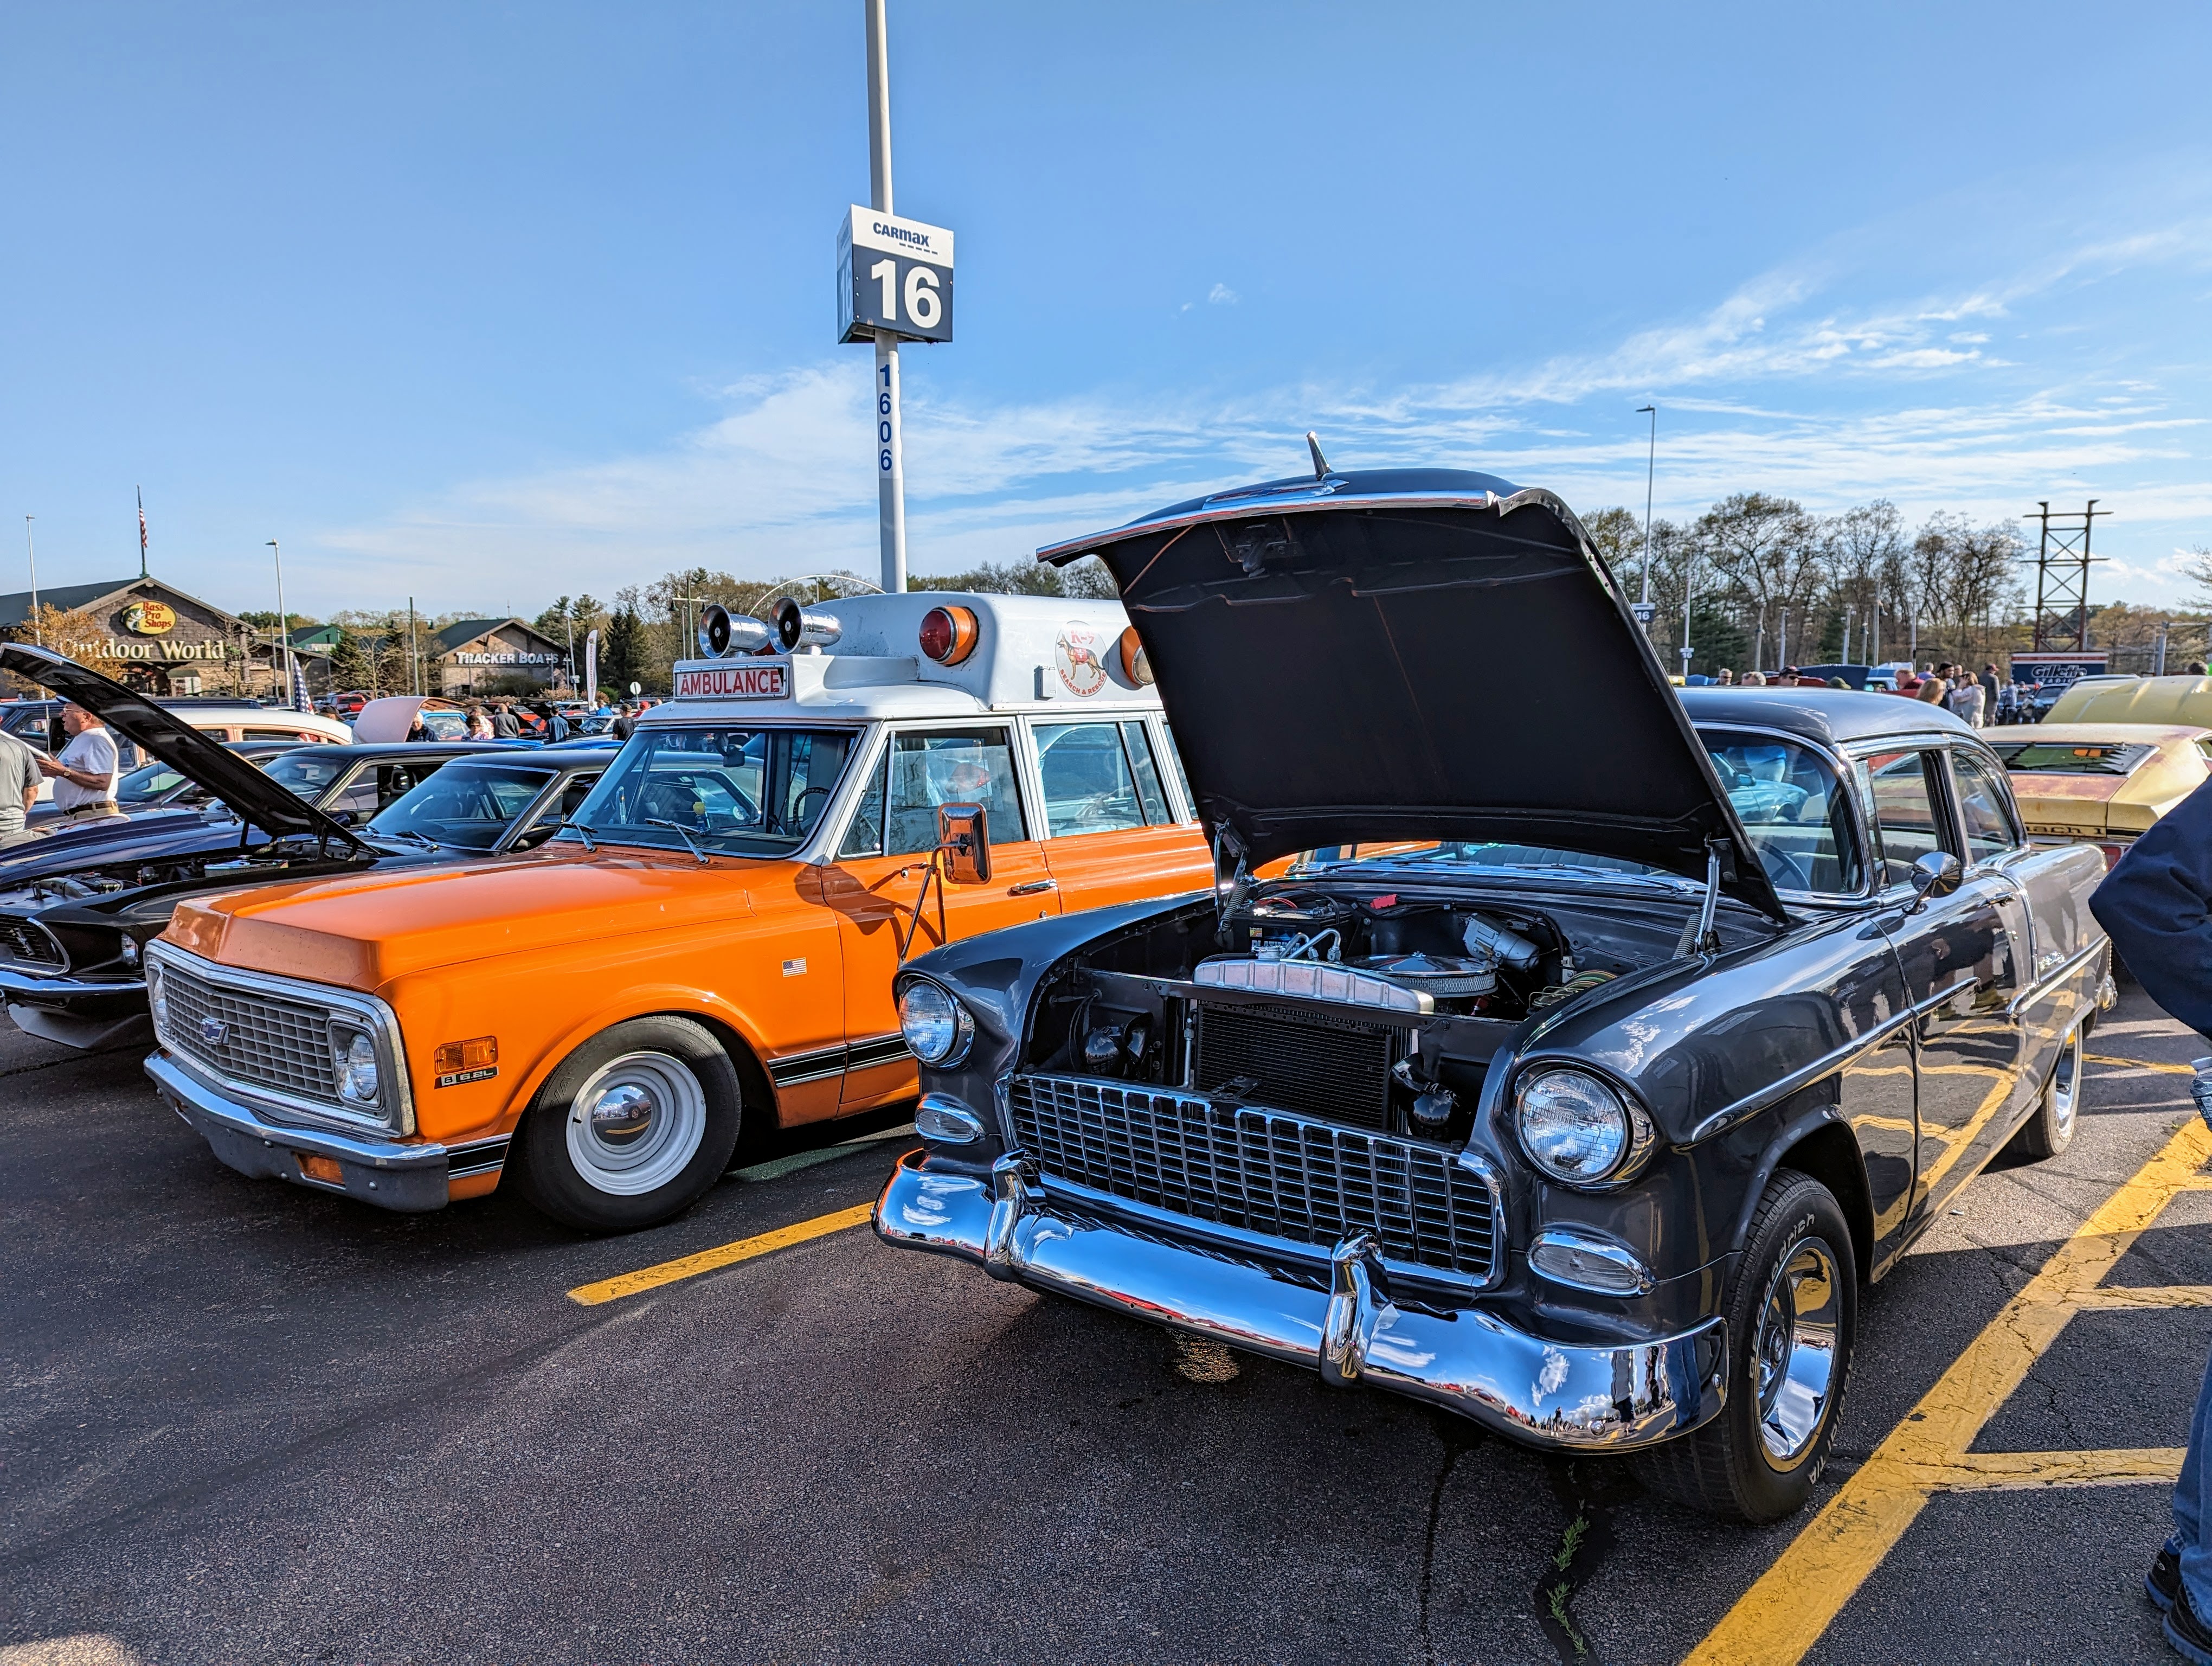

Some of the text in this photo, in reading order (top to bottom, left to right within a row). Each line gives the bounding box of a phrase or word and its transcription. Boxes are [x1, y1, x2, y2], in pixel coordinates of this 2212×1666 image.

[871, 259, 941, 328] 16
[879, 364, 892, 471] 1606
[142, 602, 164, 611] Bass
[145, 611, 161, 619] Pro
[1637, 611, 1650, 620] 16
[144, 619, 171, 629] Shops
[158, 639, 226, 659] World
[456, 652, 558, 664] TRACKER BOATS
[2031, 665, 2087, 678] Gillette
[680, 670, 780, 695] AMBULANCE
[1060, 669, 1081, 694] SEARCH
[1088, 671, 1107, 694] RESCUE
[460, 1070, 493, 1081] 6.2L
